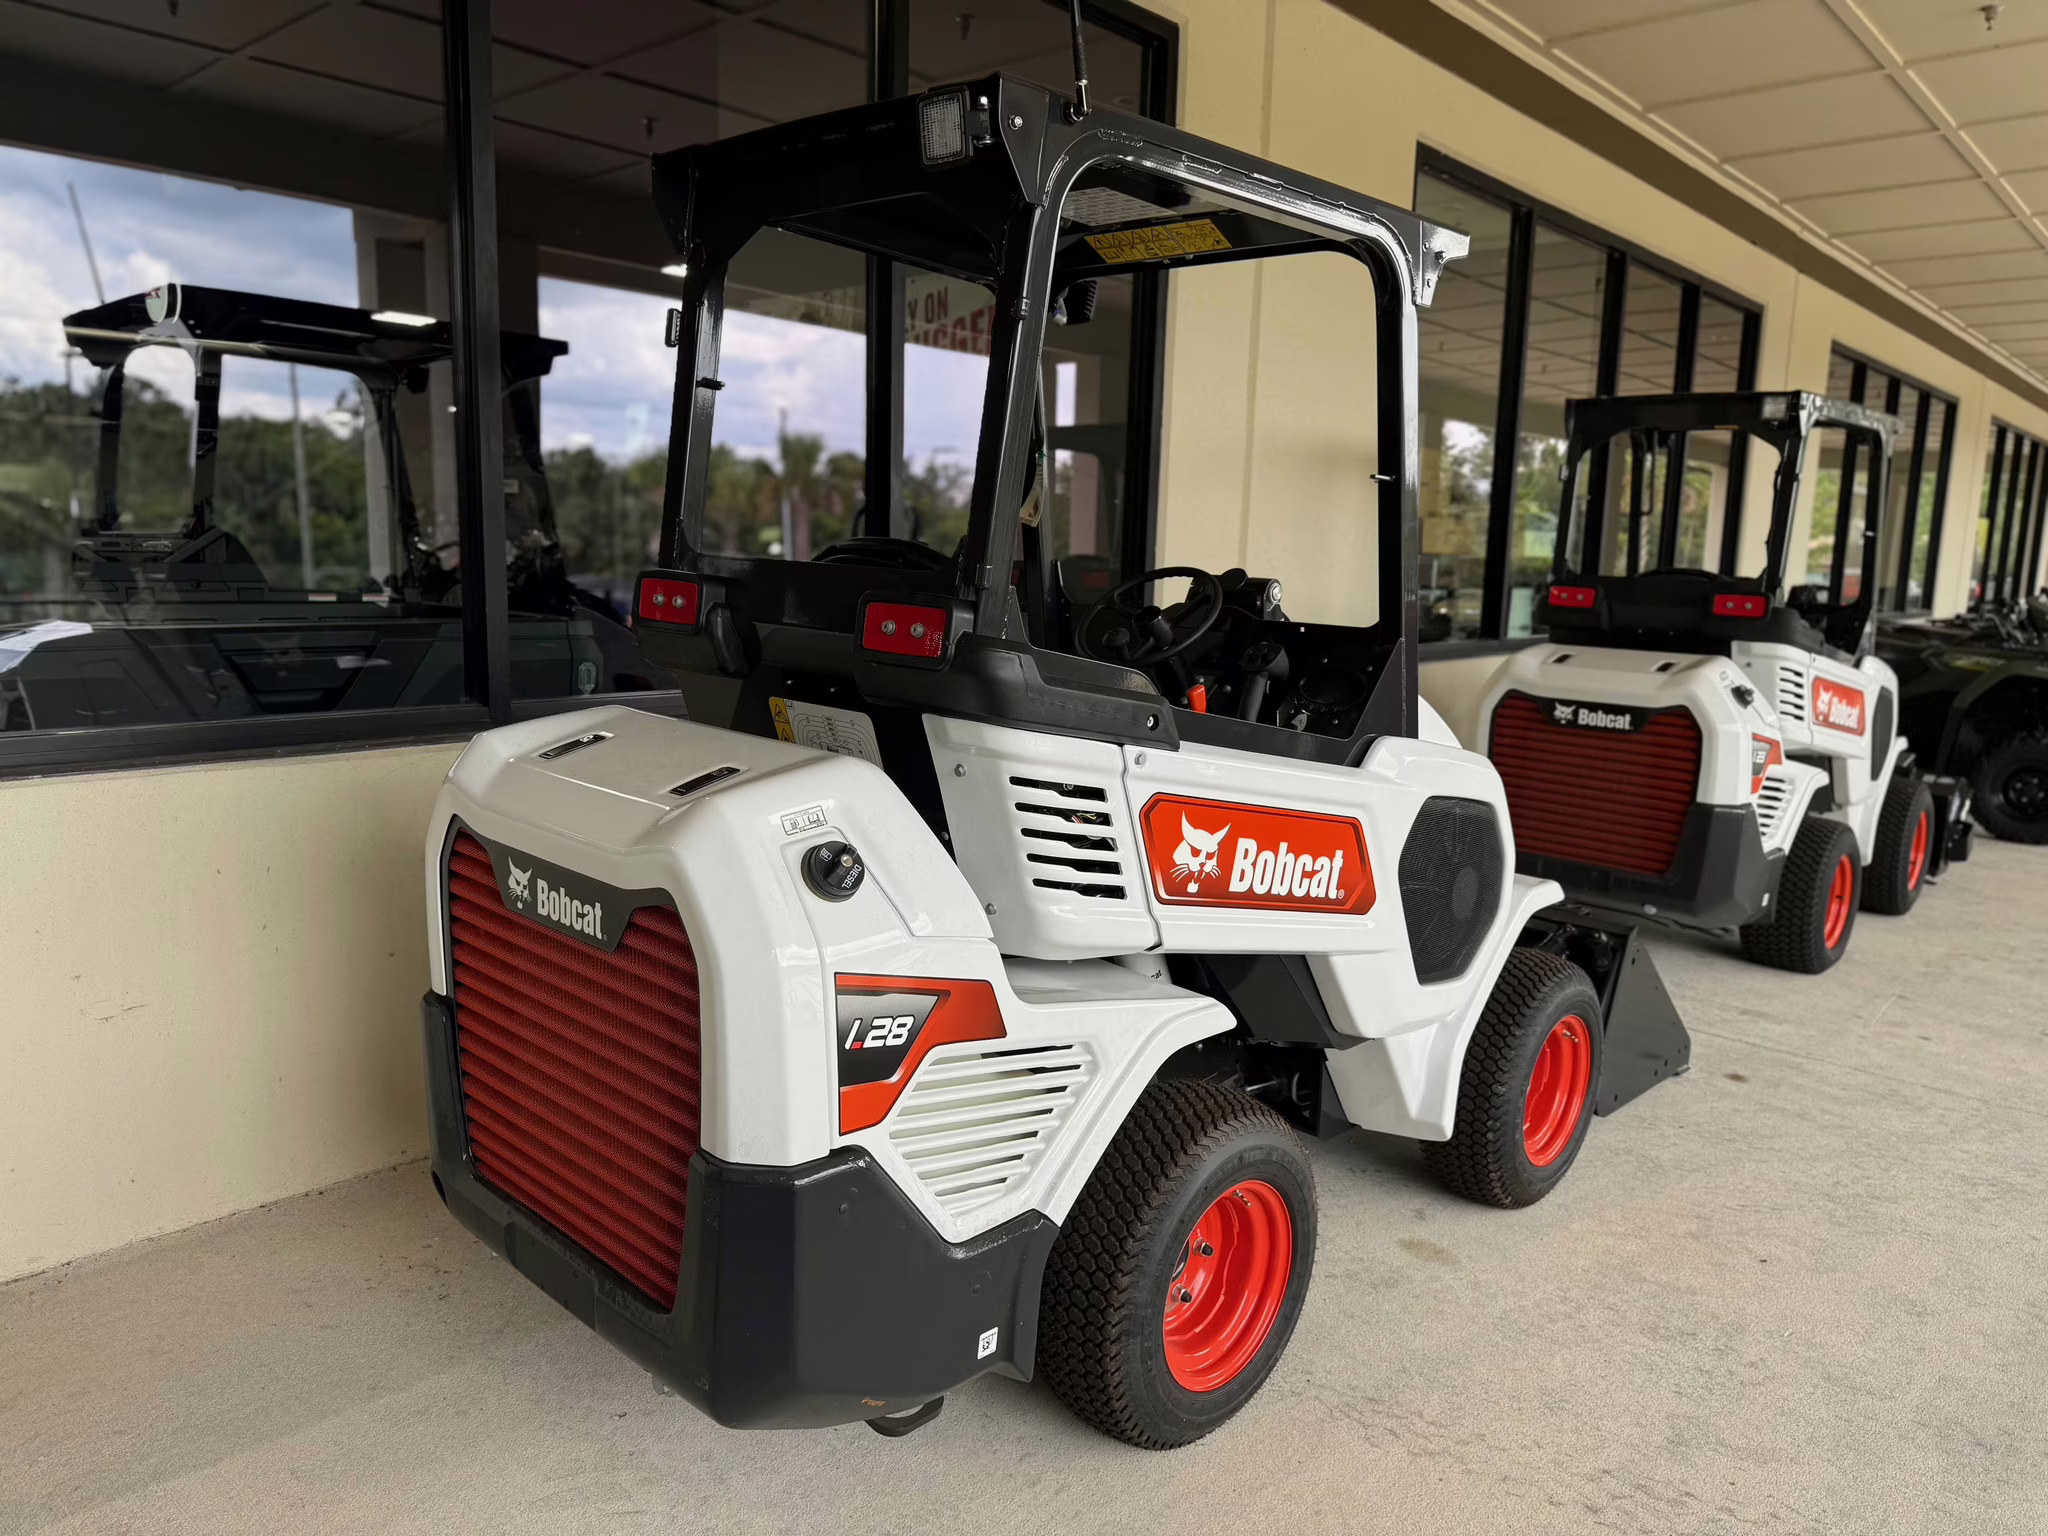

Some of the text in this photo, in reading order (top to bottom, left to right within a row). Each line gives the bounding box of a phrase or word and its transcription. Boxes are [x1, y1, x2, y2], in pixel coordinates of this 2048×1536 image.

[1577, 708, 1631, 730] Bobcat
[841, 863, 862, 889] DIESEL
[1228, 837, 1344, 899] Bobcat
[537, 878, 602, 940] Bobcat
